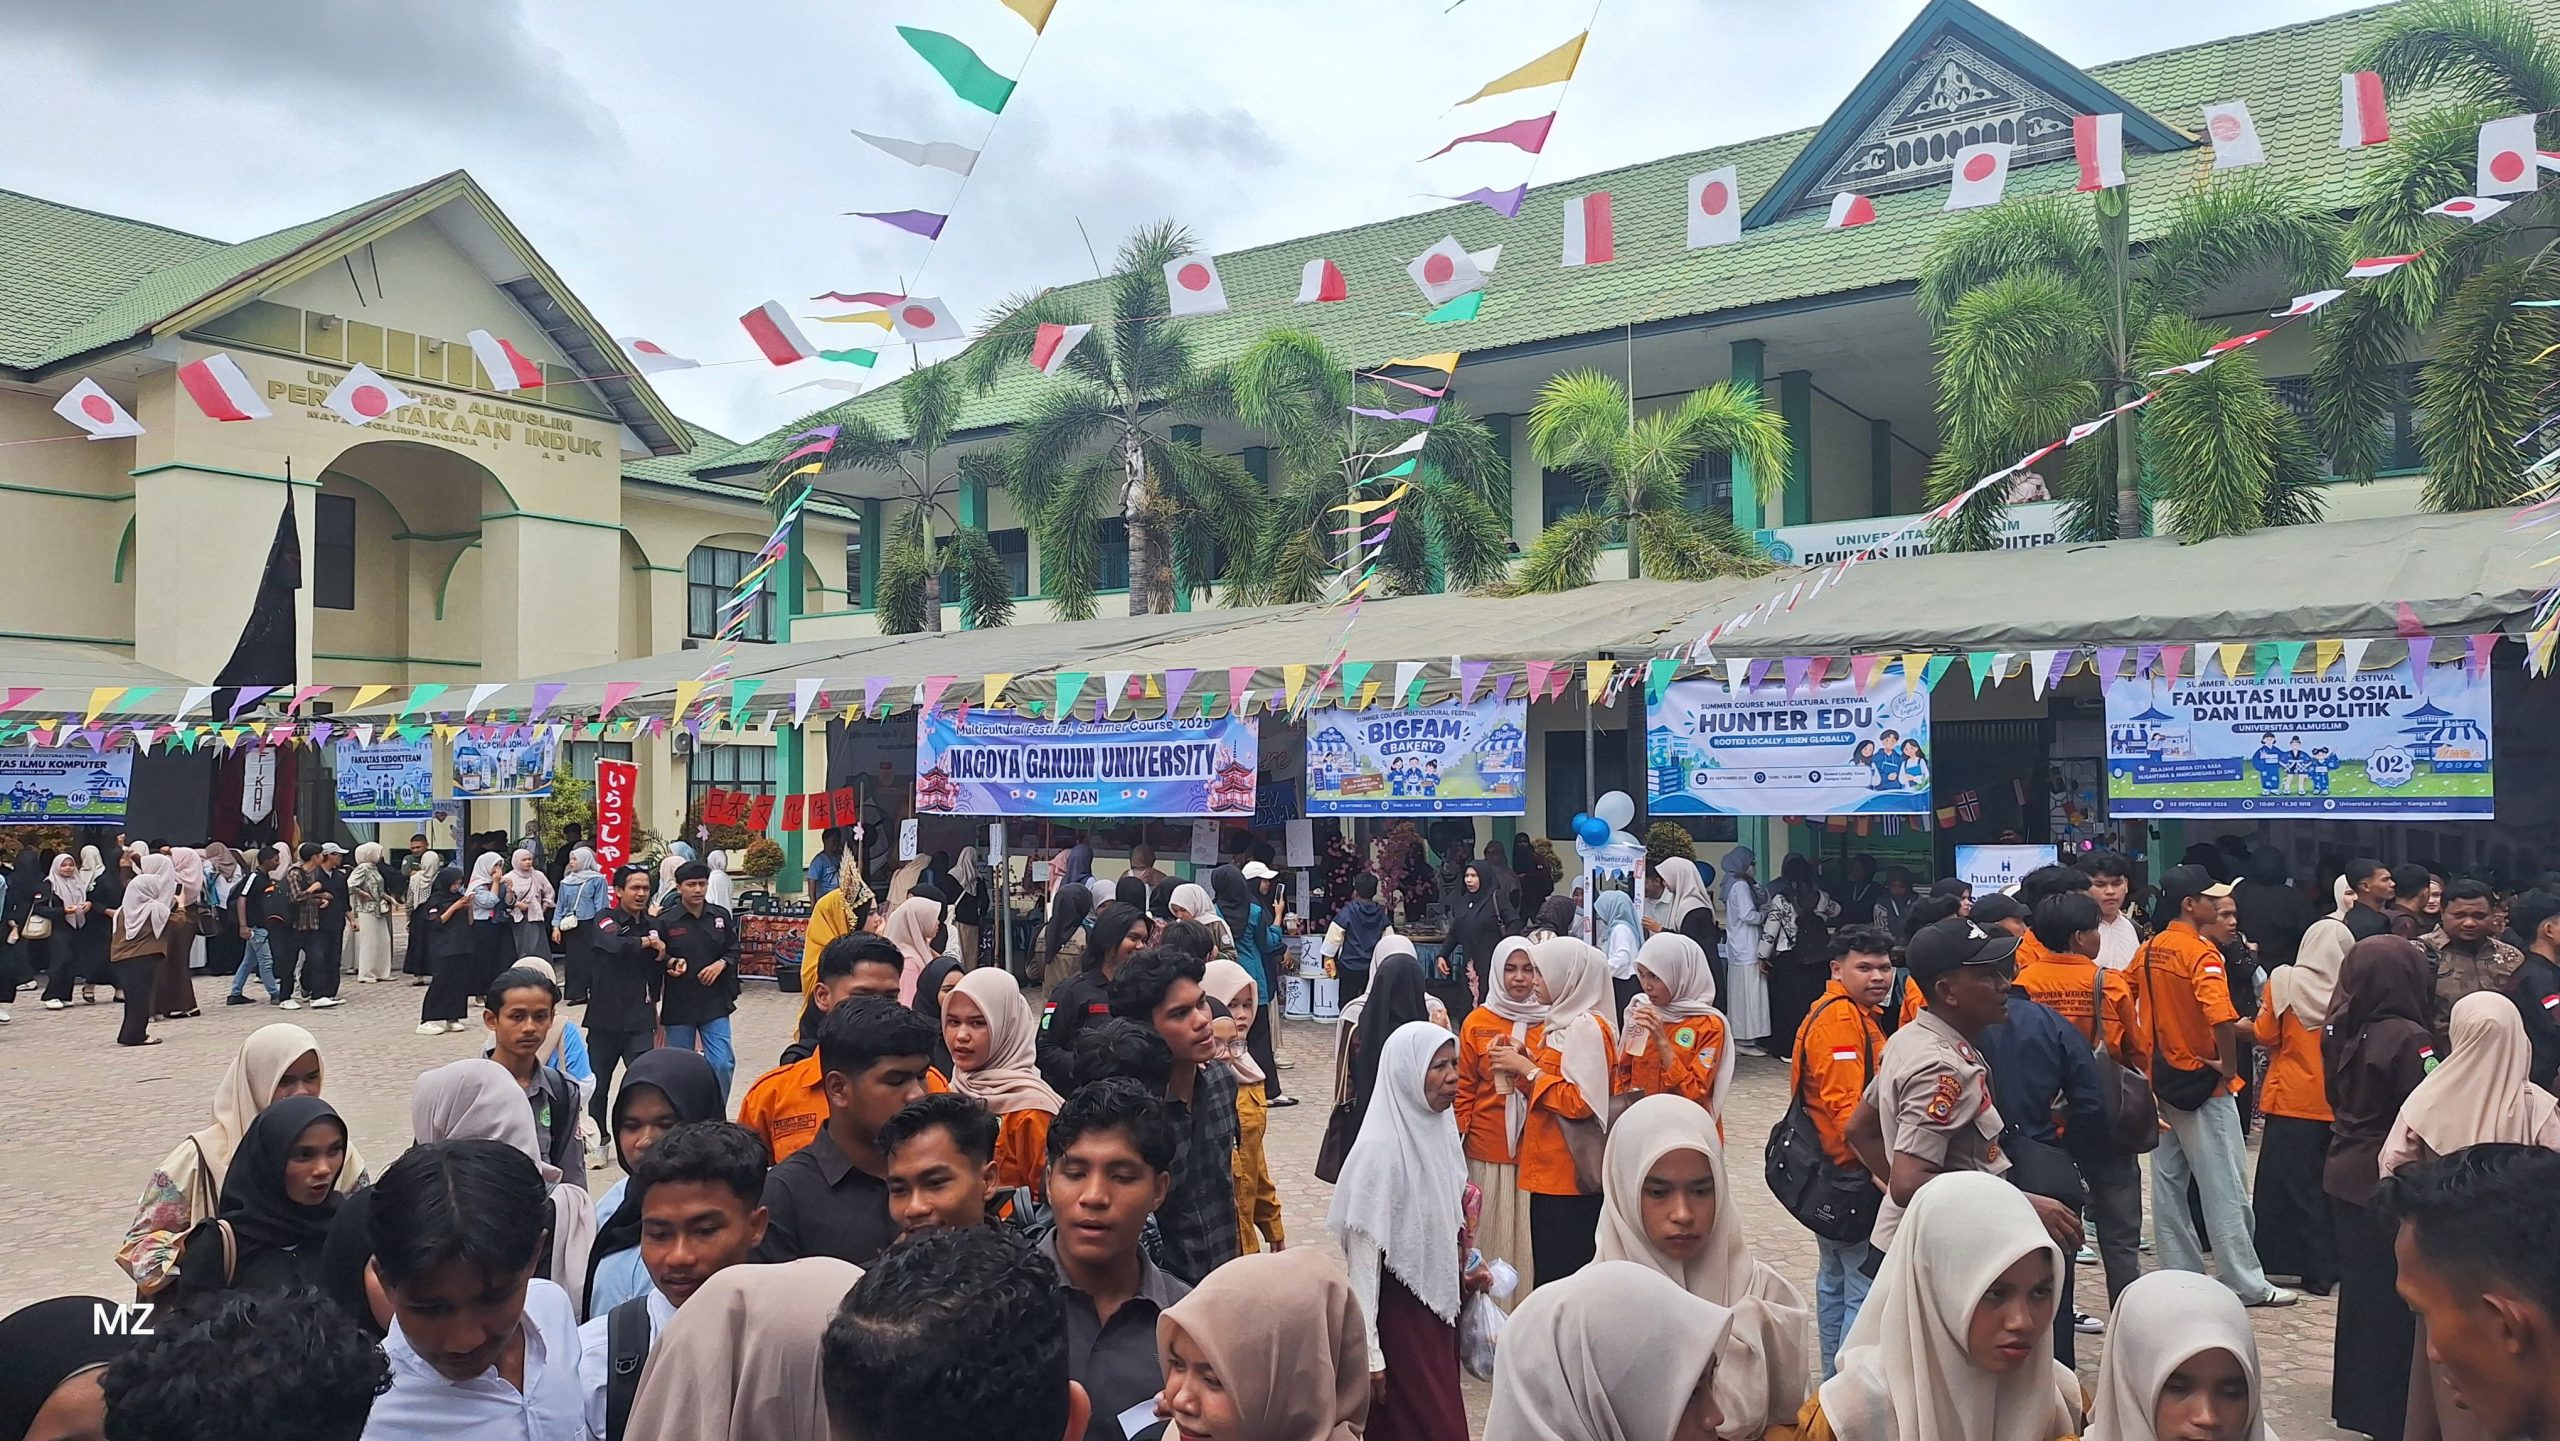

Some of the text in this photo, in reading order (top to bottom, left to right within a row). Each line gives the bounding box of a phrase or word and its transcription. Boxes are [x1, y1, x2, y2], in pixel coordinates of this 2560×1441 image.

[468, 401, 572, 432] ALMUSLIM
[525, 427, 602, 457] INDUK
[1735, 701, 1764, 709] COURSE
[1767, 699, 1829, 708] MULTCULTURAL
[1831, 697, 1869, 705] FESTIVAL
[2172, 684, 2413, 706] FAKULTAS ILMU SOSIAL
[1357, 714, 1379, 722] SUMMER
[1381, 711, 1402, 719] COURSE
[1700, 707, 1872, 733] HUNTER EDU
[2193, 702, 2391, 721] DAN ILMU POLITIK
[956, 723, 1027, 736] Multicultural
[1077, 722, 1127, 733] Summer
[1130, 720, 1173, 731] Course
[1179, 719, 1211, 729] 2026
[1368, 719, 1462, 744] BIGFAM
[2239, 722, 2342, 732] UNIVERSITAS ALMUSLIM
[2445, 720, 2474, 728] Bakery
[1390, 741, 1437, 752] BAKERY
[1714, 735, 1851, 746] ROOTED LOCALLY, RISEN GLOBALLY
[49, 761, 108, 769] KOMPUTER
[351, 754, 421, 764] FAKULTAS KEDOKTERAN
[951, 743, 1217, 779] NAGOYA GAKUIN UNIVERSITY
[2376, 755, 2404, 773] 02
[1055, 791, 1098, 804] JAPAN
[1315, 985, 1332, 1008] 山
